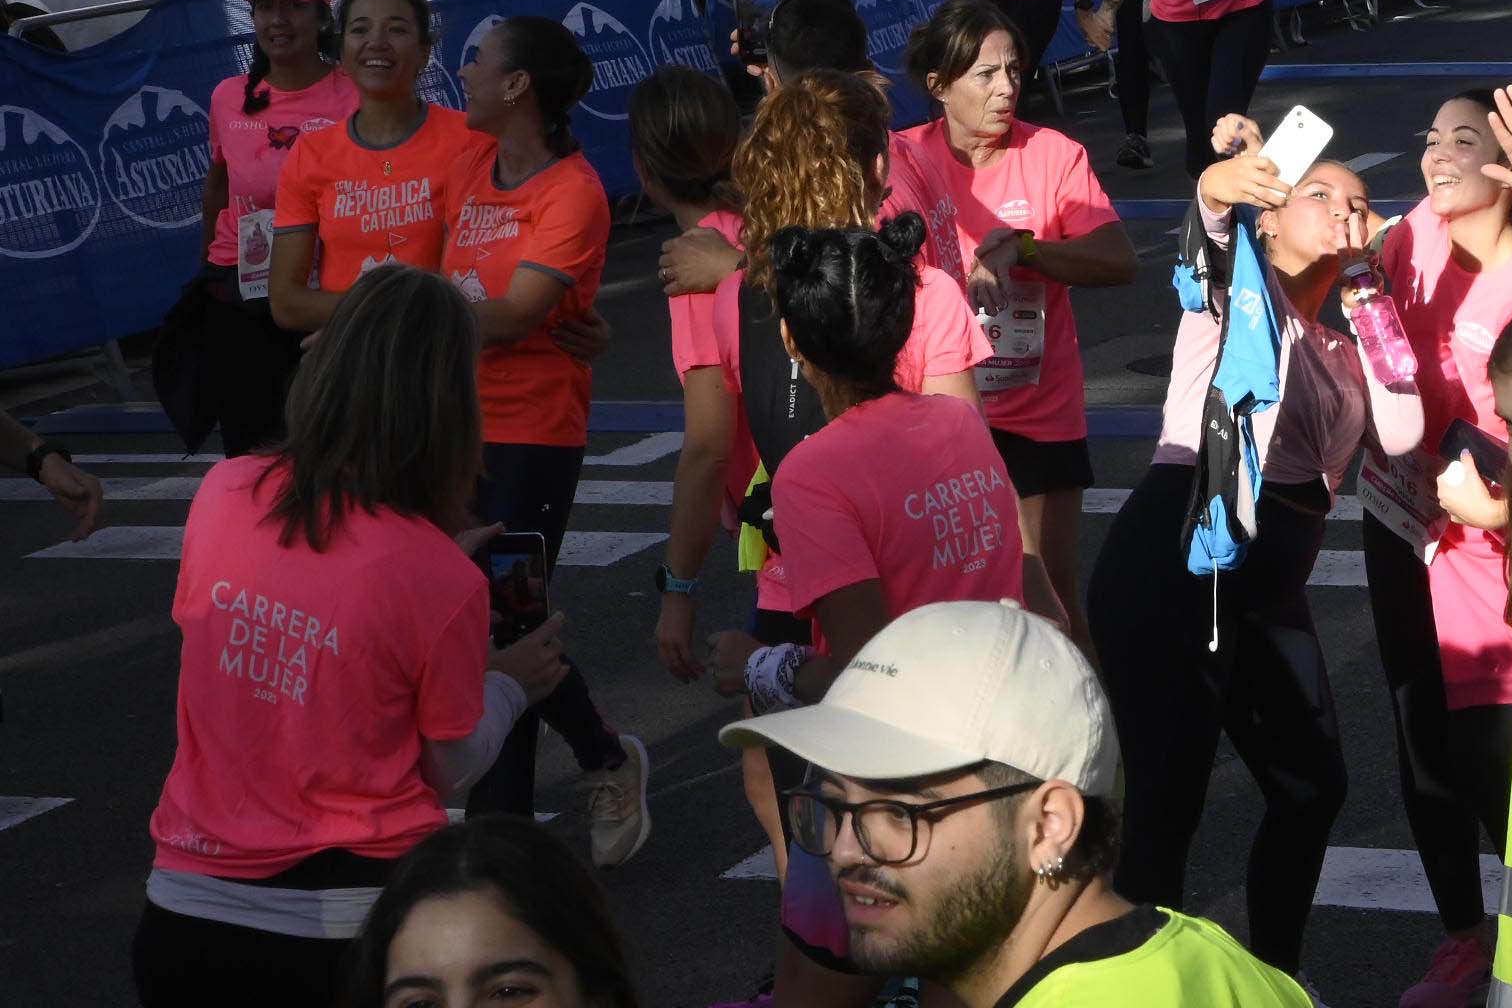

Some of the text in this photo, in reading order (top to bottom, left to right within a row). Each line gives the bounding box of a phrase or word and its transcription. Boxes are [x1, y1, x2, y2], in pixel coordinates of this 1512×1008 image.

[111, 145, 211, 201] ASTURIAN
[333, 177, 432, 219] REPÚBLICA
[360, 202, 434, 233] CATALANA
[456, 221, 520, 248] CATALANA
[904, 465, 1006, 521] CARRERA
[932, 500, 999, 542] DE LA
[932, 524, 1005, 571] MUJER
[210, 580, 340, 656] CARRERA
[228, 618, 309, 673] DE LA
[219, 646, 309, 706] MUJER
